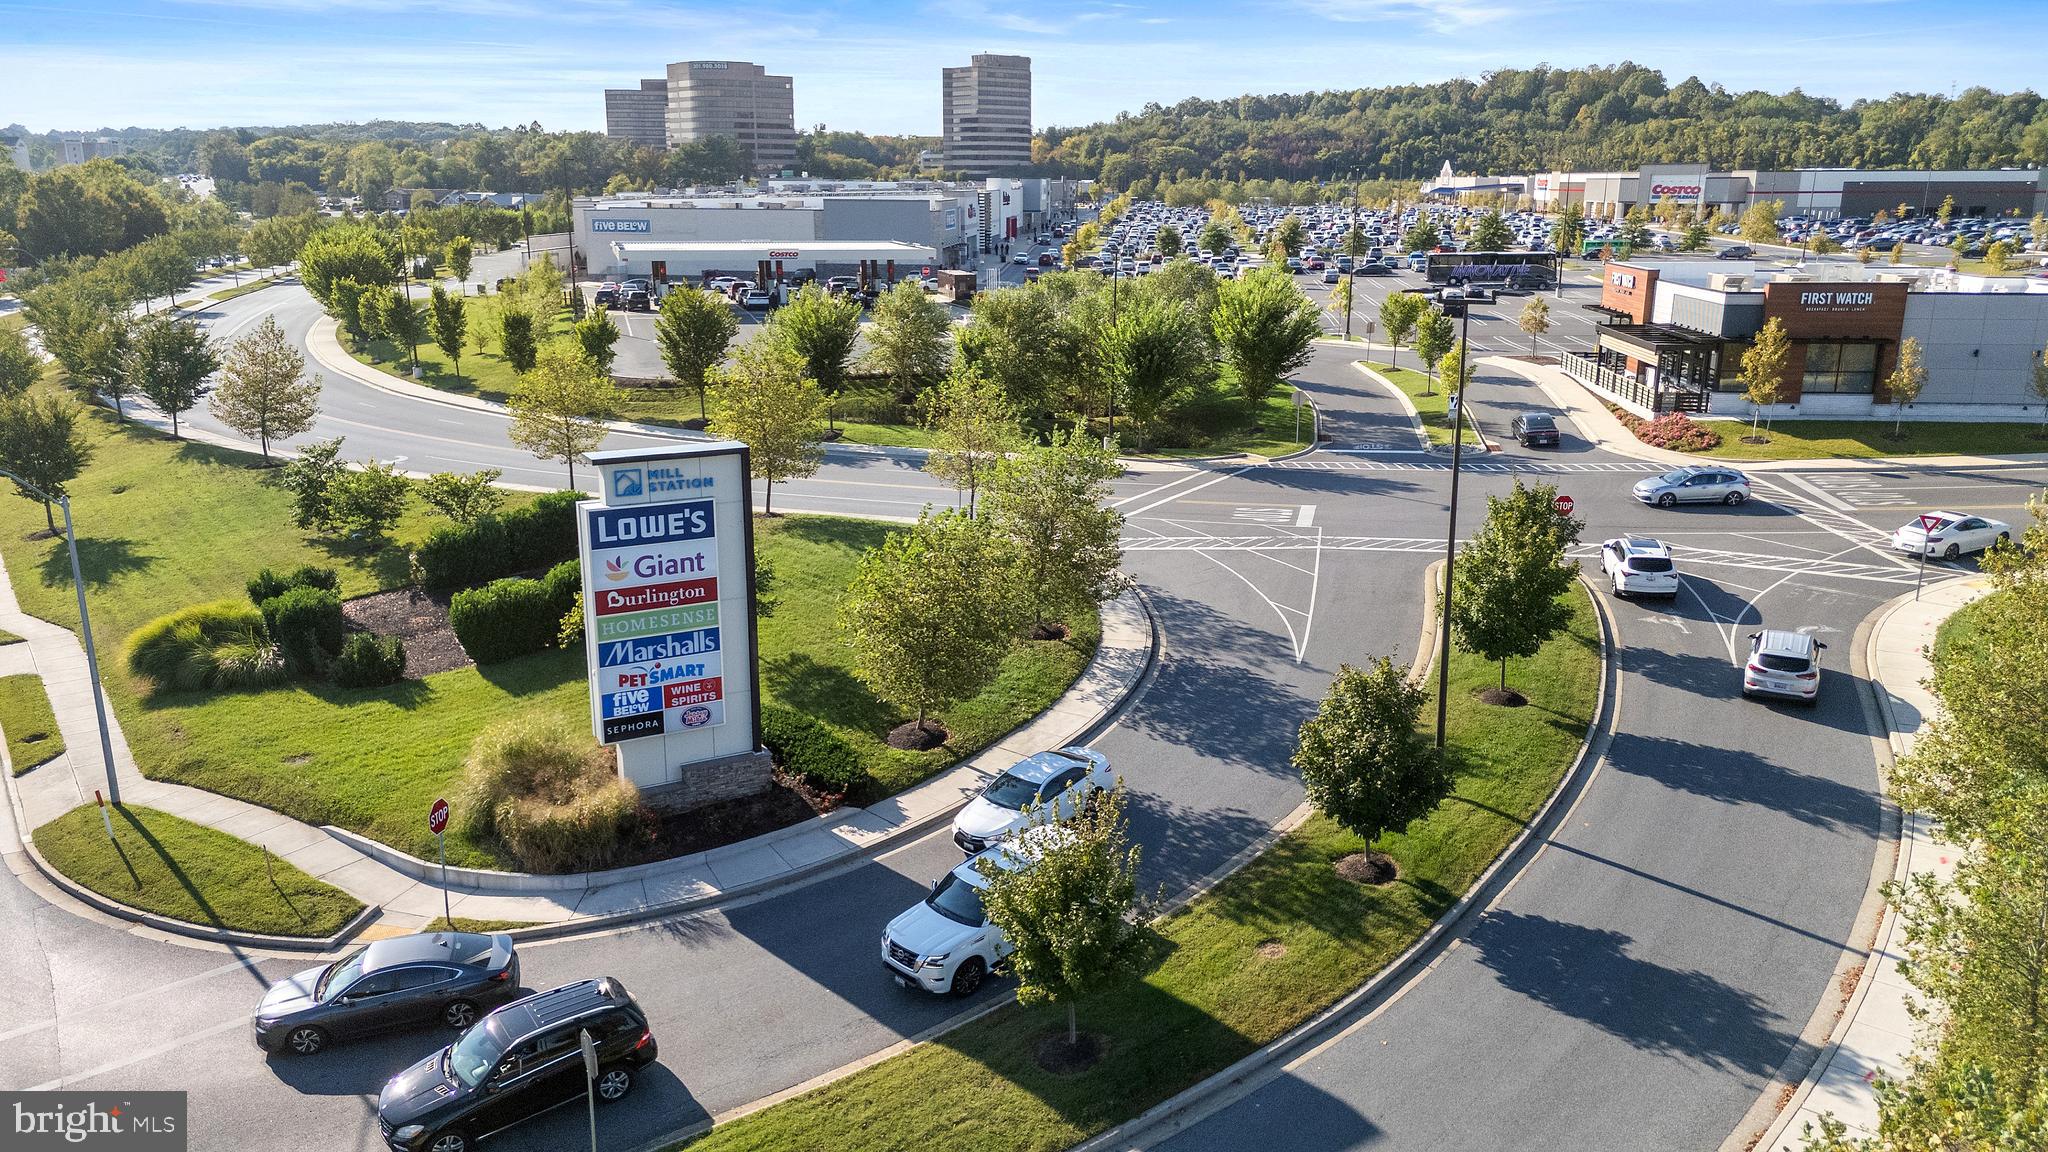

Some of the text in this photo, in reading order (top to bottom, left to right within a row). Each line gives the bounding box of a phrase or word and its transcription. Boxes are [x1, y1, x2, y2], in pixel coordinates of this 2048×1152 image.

[1652, 184, 1701, 194] COSTCO
[594, 221, 647, 231] five BELOW
[1800, 292, 1873, 305] FIRST WATCH
[648, 468, 684, 479] MILL
[648, 477, 713, 492] STATION
[1554, 502, 1573, 510] STOP
[597, 508, 707, 543] LOWE'S
[634, 552, 705, 578] Giant
[607, 586, 705, 608] Burlington
[601, 608, 715, 636] HOMESENSE
[604, 631, 715, 666] Marshalls
[671, 683, 702, 696] WINE
[612, 690, 650, 707] five
[671, 692, 717, 706] SPIRITS
[613, 702, 650, 716] BELOW
[607, 719, 659, 735] SEPHORA
[430, 806, 448, 828] STOP
